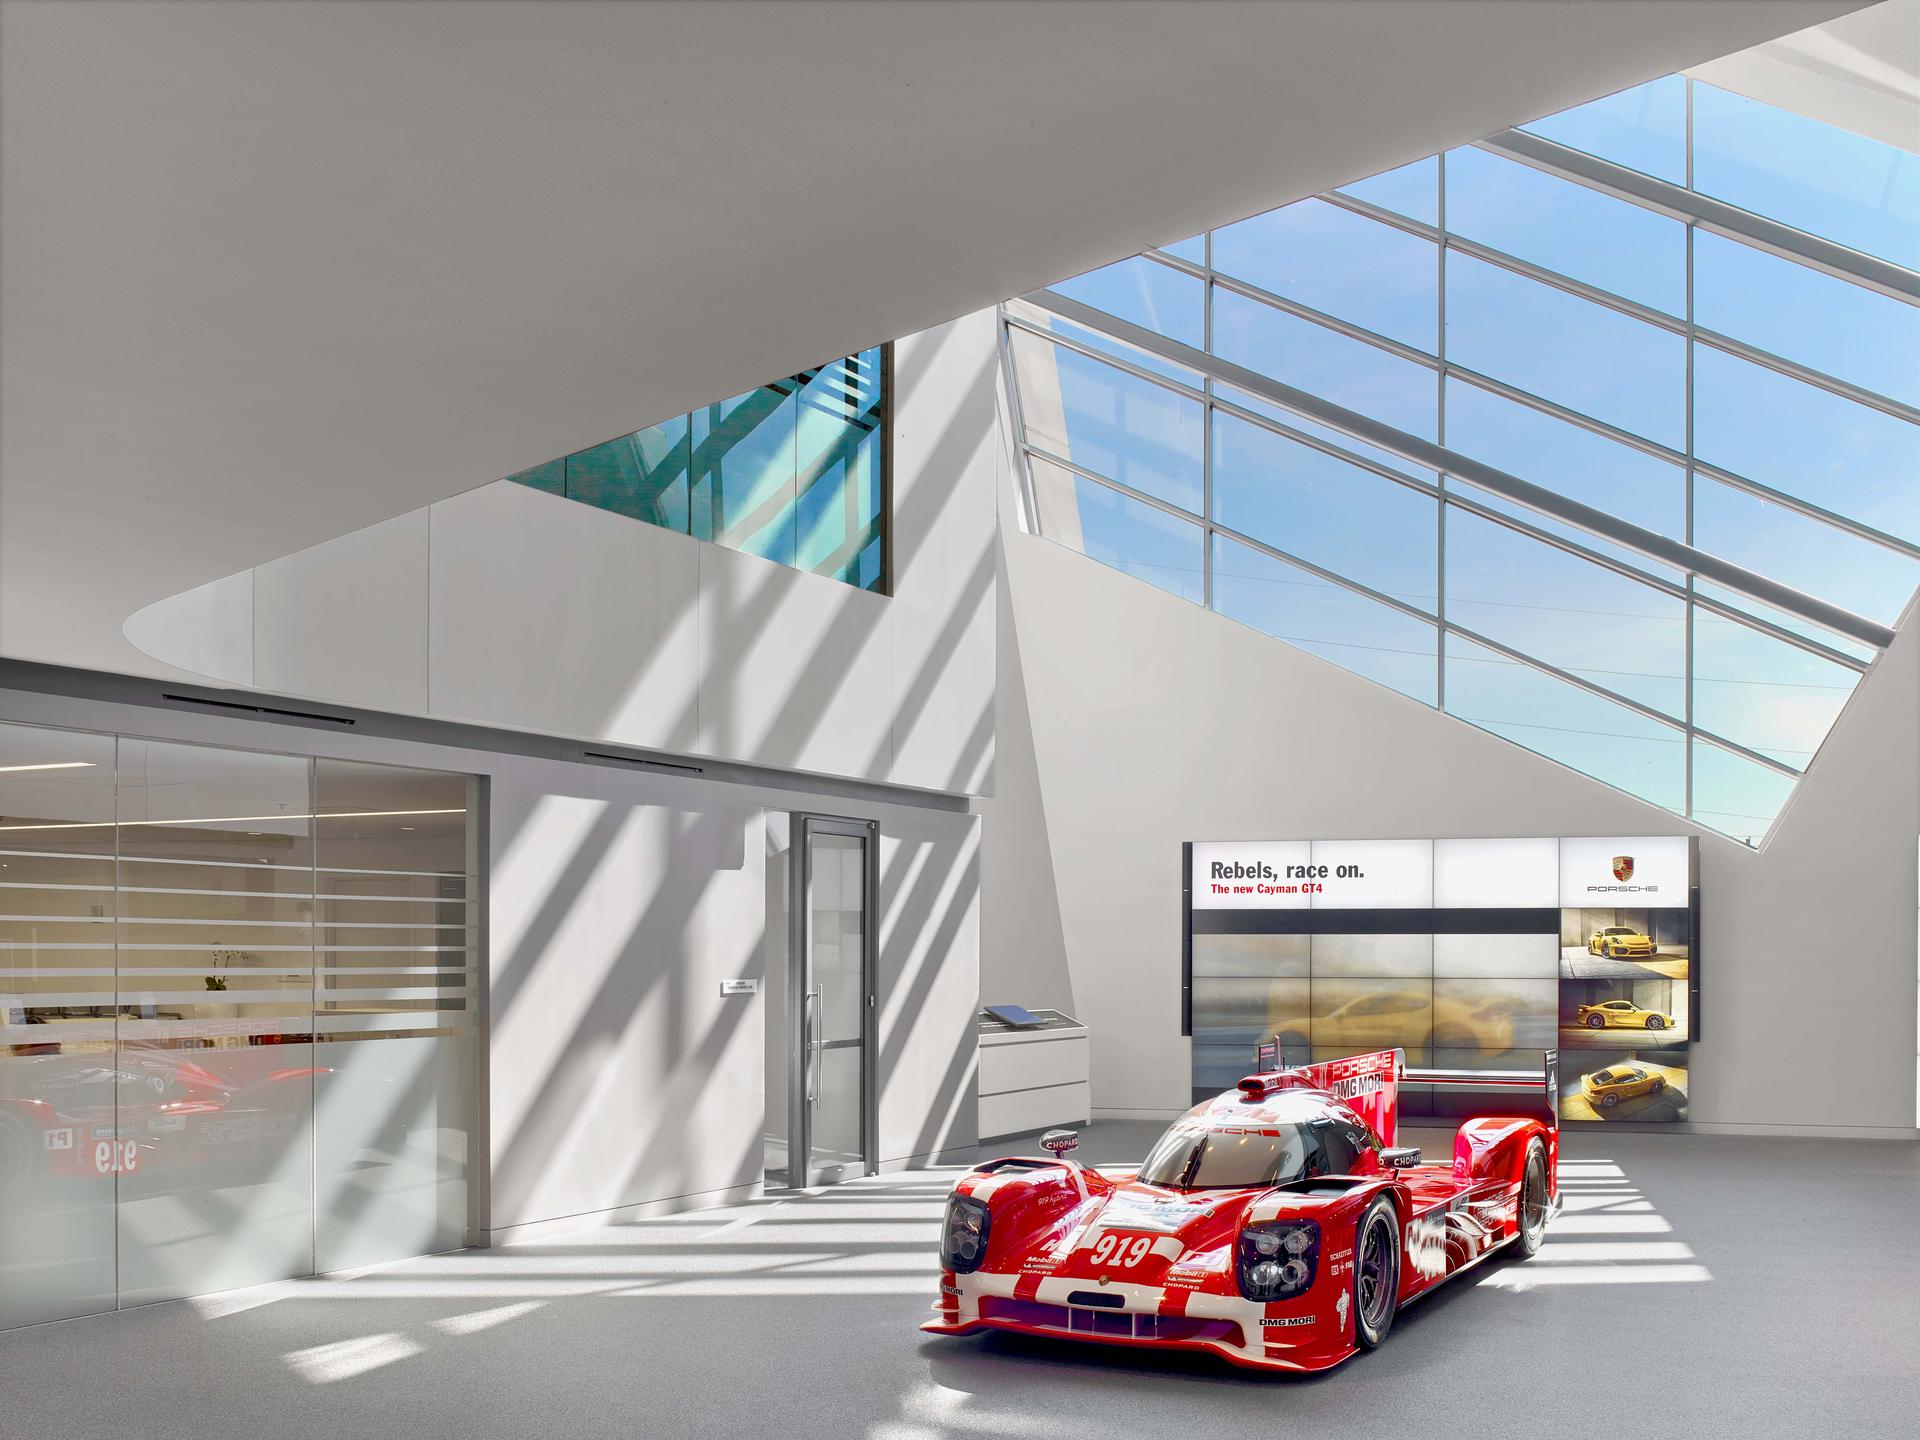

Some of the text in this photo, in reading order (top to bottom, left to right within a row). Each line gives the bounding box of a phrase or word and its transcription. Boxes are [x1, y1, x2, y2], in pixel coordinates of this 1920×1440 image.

[1211, 861, 1364, 882] Rebels, race on.
[1211, 883, 1323, 895] The new Cayman GT4
[1333, 1053, 1392, 1080] PORSCHE
[1358, 1071, 1384, 1095] MORI
[1090, 1235, 1151, 1268] 919
[1162, 1281, 1200, 1290] CHOPARD
[1288, 1316, 1316, 1325] MORI
